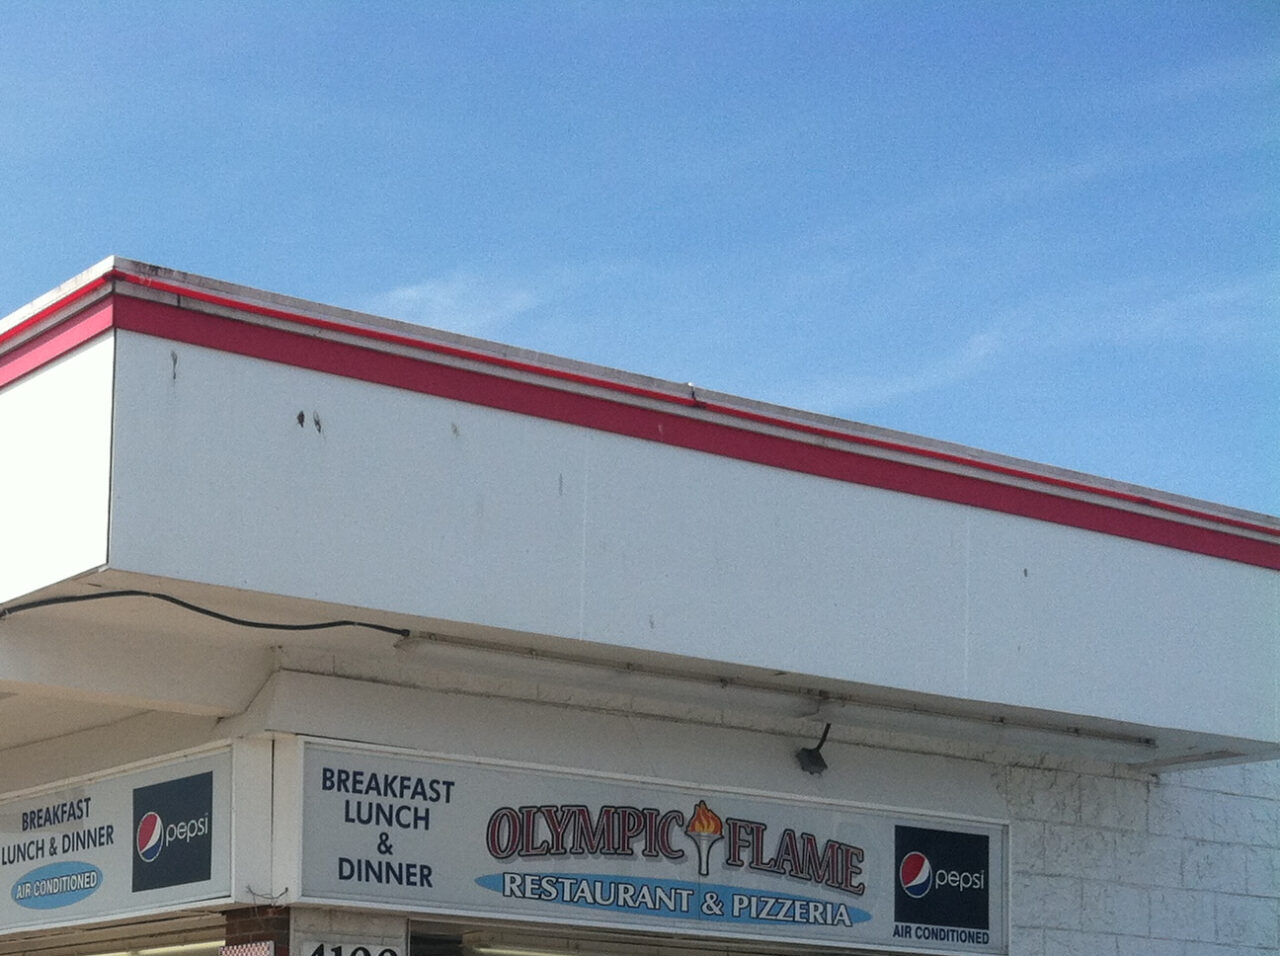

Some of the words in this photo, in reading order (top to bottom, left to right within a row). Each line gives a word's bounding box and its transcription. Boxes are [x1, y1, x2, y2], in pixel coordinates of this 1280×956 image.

[321, 767, 456, 805] BREAKFAST
[21, 797, 91, 832] BREAKFAST
[165, 812, 209, 847] pepsi
[343, 799, 430, 831] LUNCH
[1, 839, 45, 866] LUNCH
[48, 838, 59, 857] &
[62, 825, 115, 856] DINNER
[376, 832, 394, 856] &
[486, 804, 688, 862] OLYMPIC
[725, 817, 867, 897] FLAME
[14, 880, 32, 900] AIR
[33, 870, 98, 898] CONDITIONED
[337, 857, 434, 889] DINNER
[934, 868, 985, 893] pepsi
[503, 871, 690, 914] RESTAURANT
[701, 891, 721, 916] &
[731, 895, 853, 928] PIZZERIA
[892, 924, 913, 940] AIR
[915, 926, 991, 946] CONDITIONED
